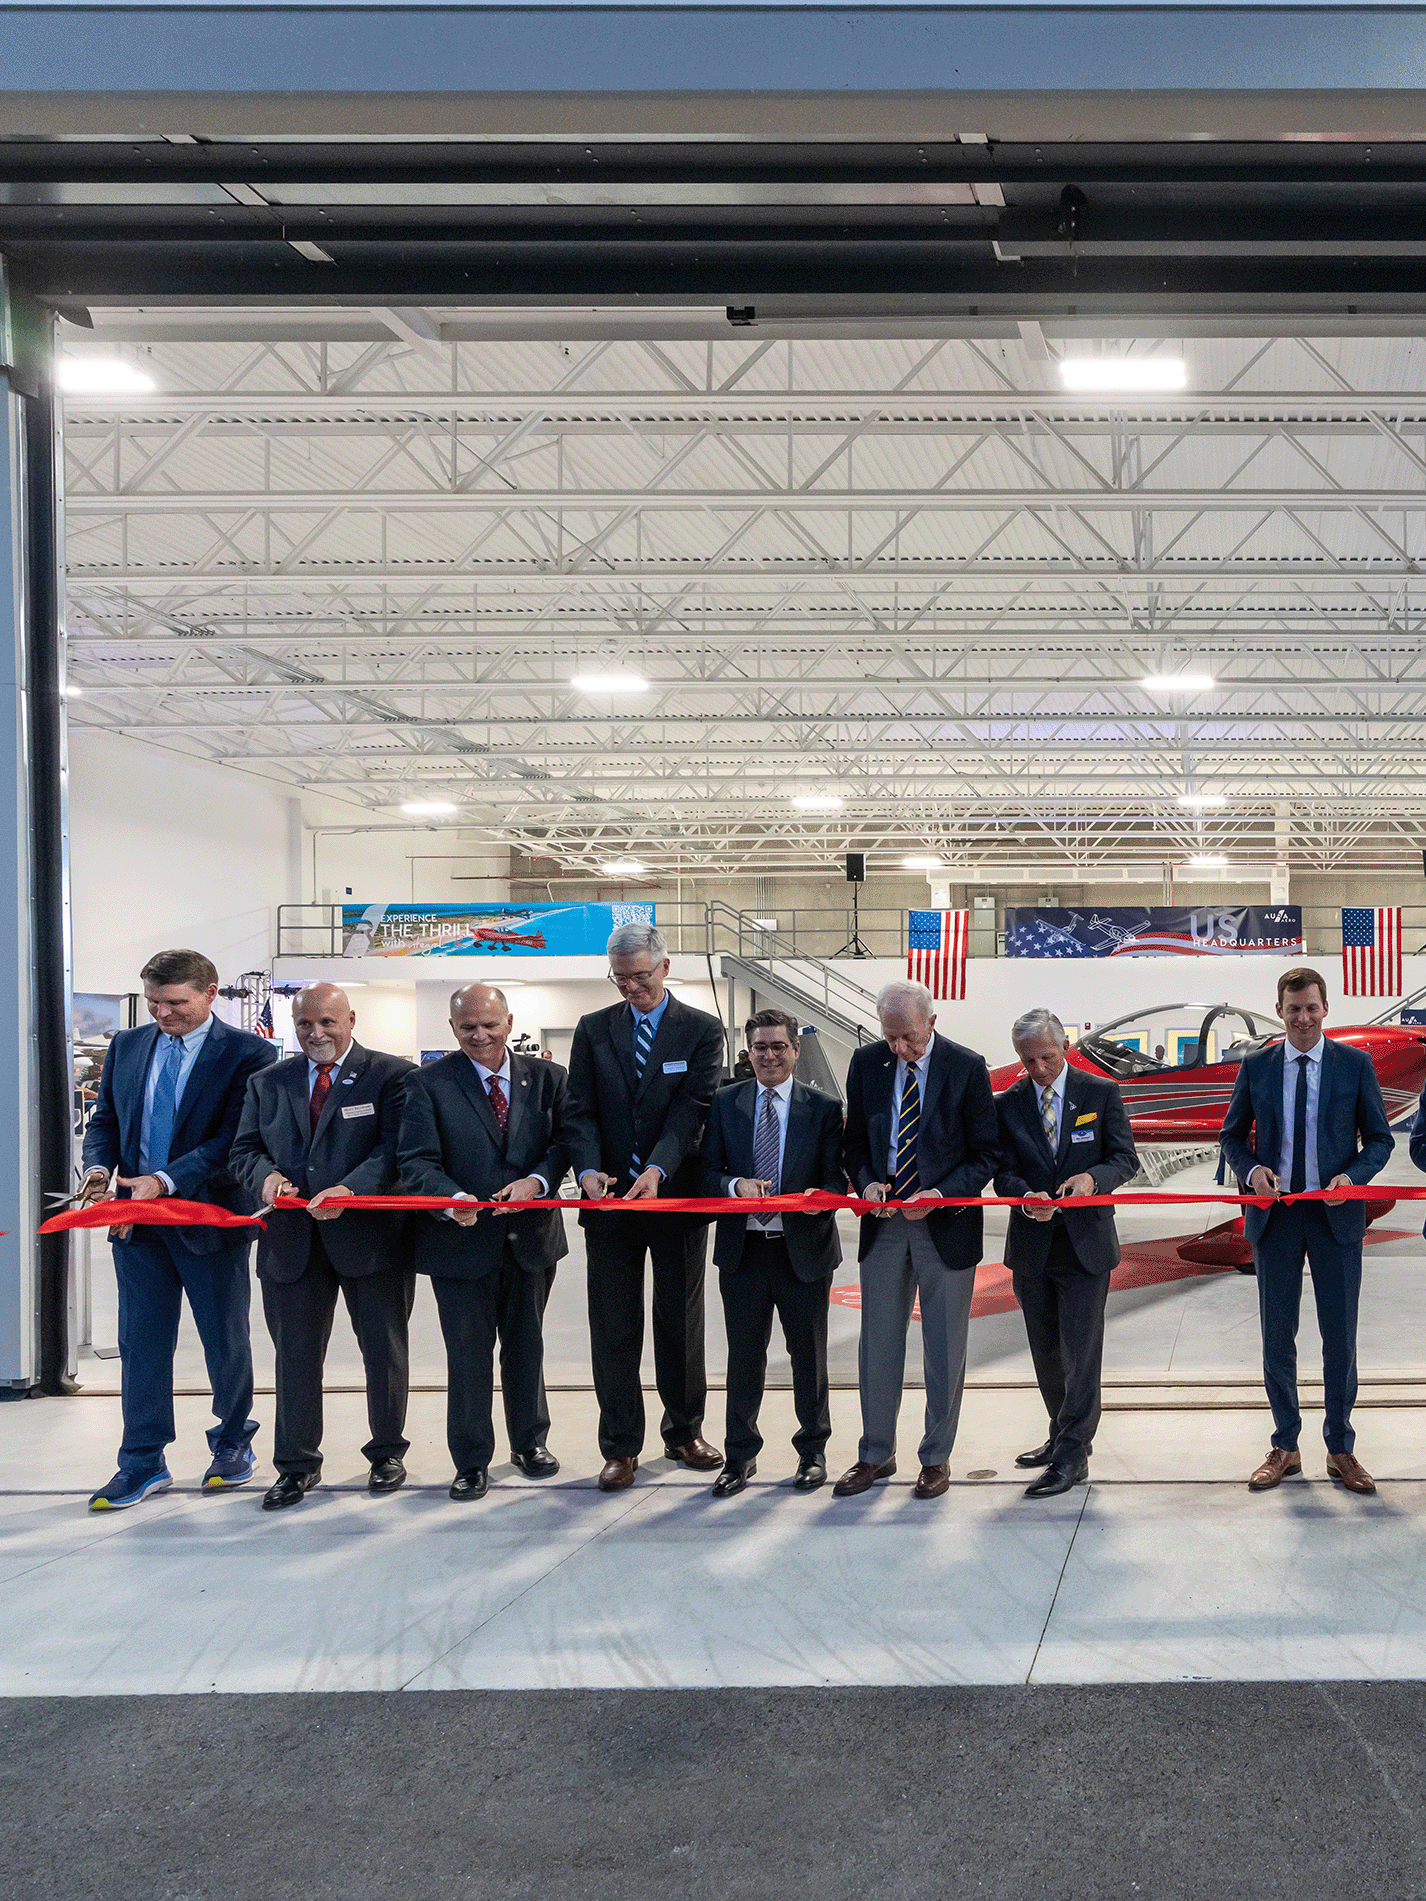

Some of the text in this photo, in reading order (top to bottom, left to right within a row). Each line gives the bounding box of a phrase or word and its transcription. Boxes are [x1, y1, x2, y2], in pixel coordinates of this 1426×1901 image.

[380, 914, 437, 922] EXPERIENCE
[380, 924, 474, 937] THE THRILL
[1190, 914, 1238, 941] US
[381, 938, 405, 947] with
[1193, 938, 1297, 947] HEADQUARTERS
